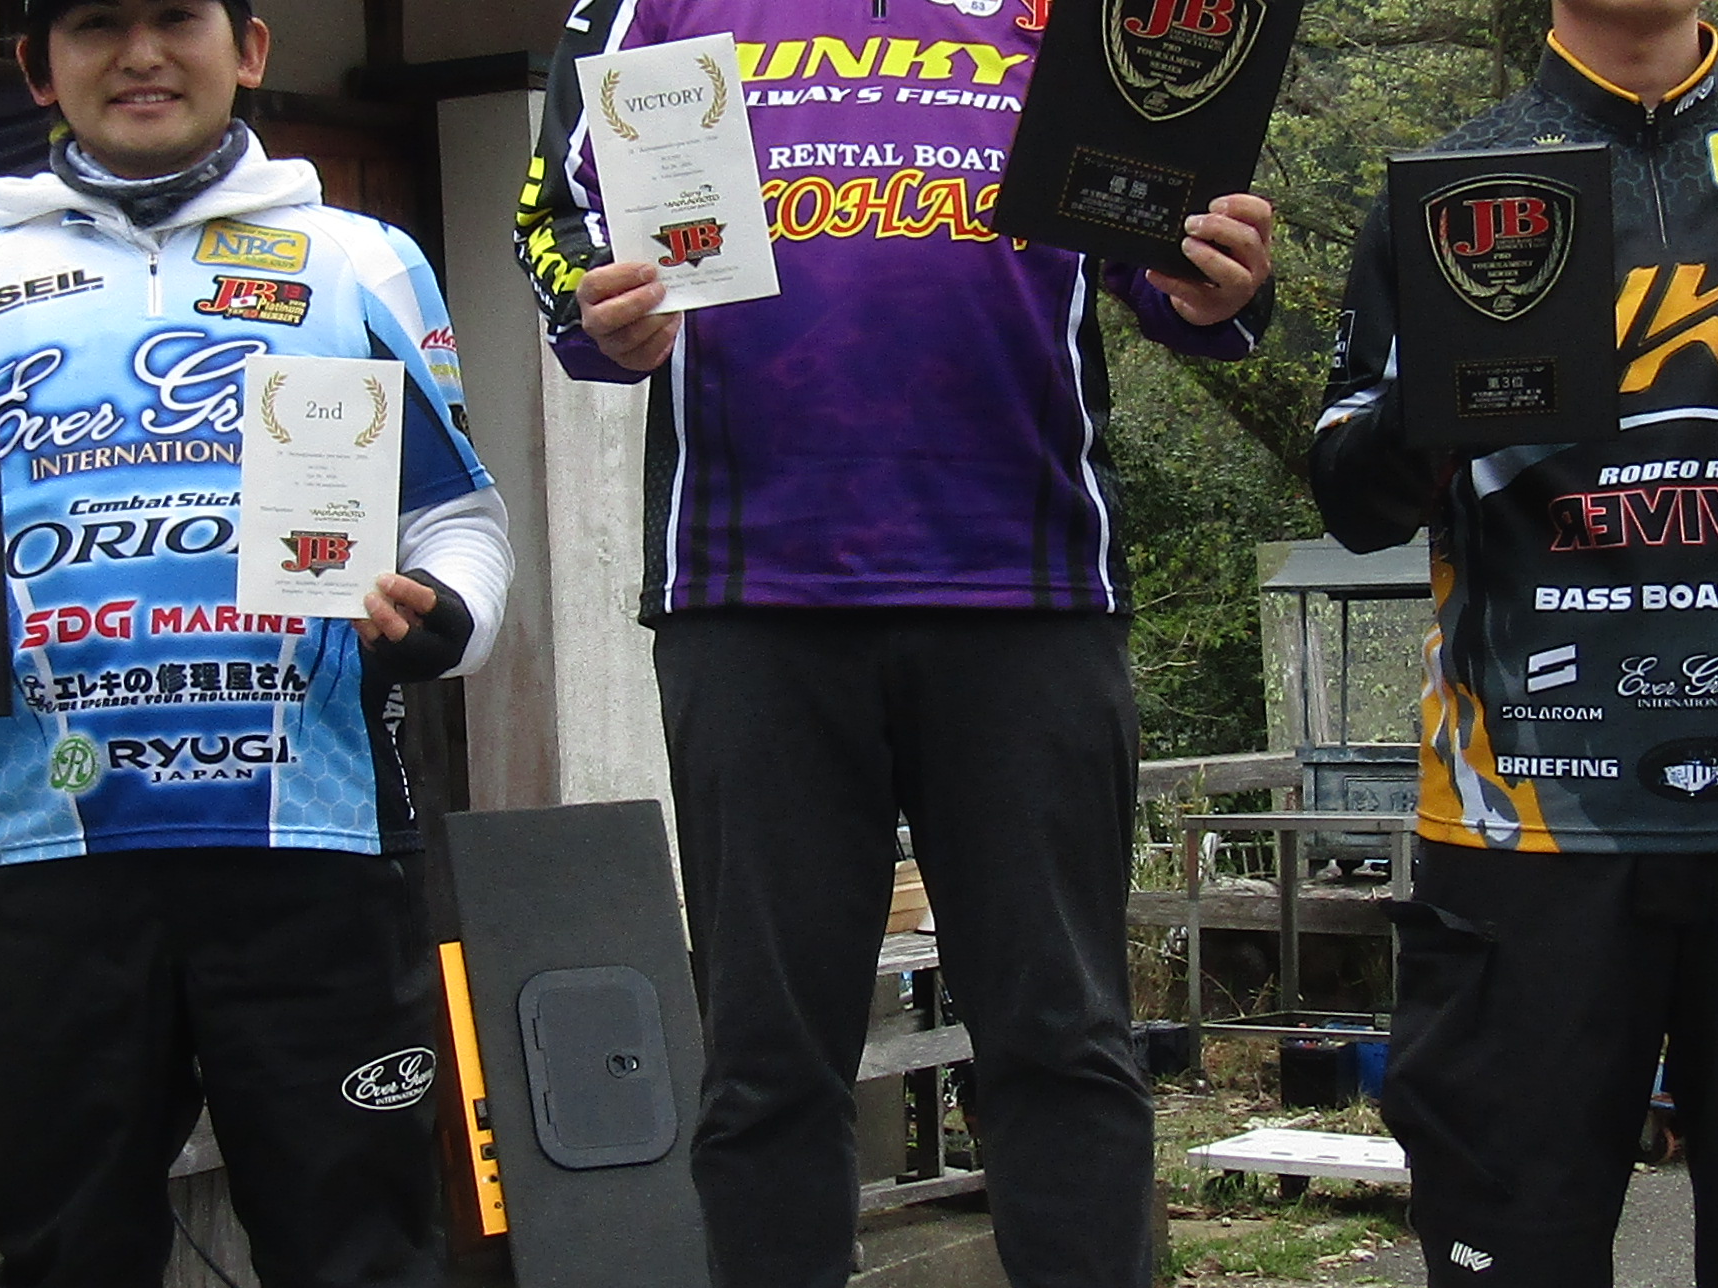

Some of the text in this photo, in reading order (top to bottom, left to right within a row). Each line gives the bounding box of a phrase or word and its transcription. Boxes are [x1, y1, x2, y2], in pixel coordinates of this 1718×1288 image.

[623, 86, 704, 113] VICTORY
[746, 85, 1022, 112] LWAYS FISHIN
[768, 144, 1005, 172] RENTAL BOAT
[1452, 196, 1550, 256] JB
[211, 231, 297, 261] NBC
[659, 223, 725, 268] JB
[305, 400, 343, 420] 2nd
[1599, 460, 1701, 486] RODEO
[69, 494, 173, 516] Combat
[6, 514, 241, 580] ORIO
[280, 534, 352, 573] JB
[1534, 584, 1632, 611] BASS
[19, 599, 307, 650] SDG MARINE
[53, 662, 308, 701] エレキの修理屋さん
[1617, 655, 1679, 698] Ever
[144, 692, 183, 705] YOUR
[1501, 705, 1604, 722] SOLAROAM
[107, 734, 292, 770] RYUGI
[151, 767, 254, 783] JAPAN
[1496, 755, 1620, 779] BRIEFING
[355, 1065, 399, 1100] Ever
